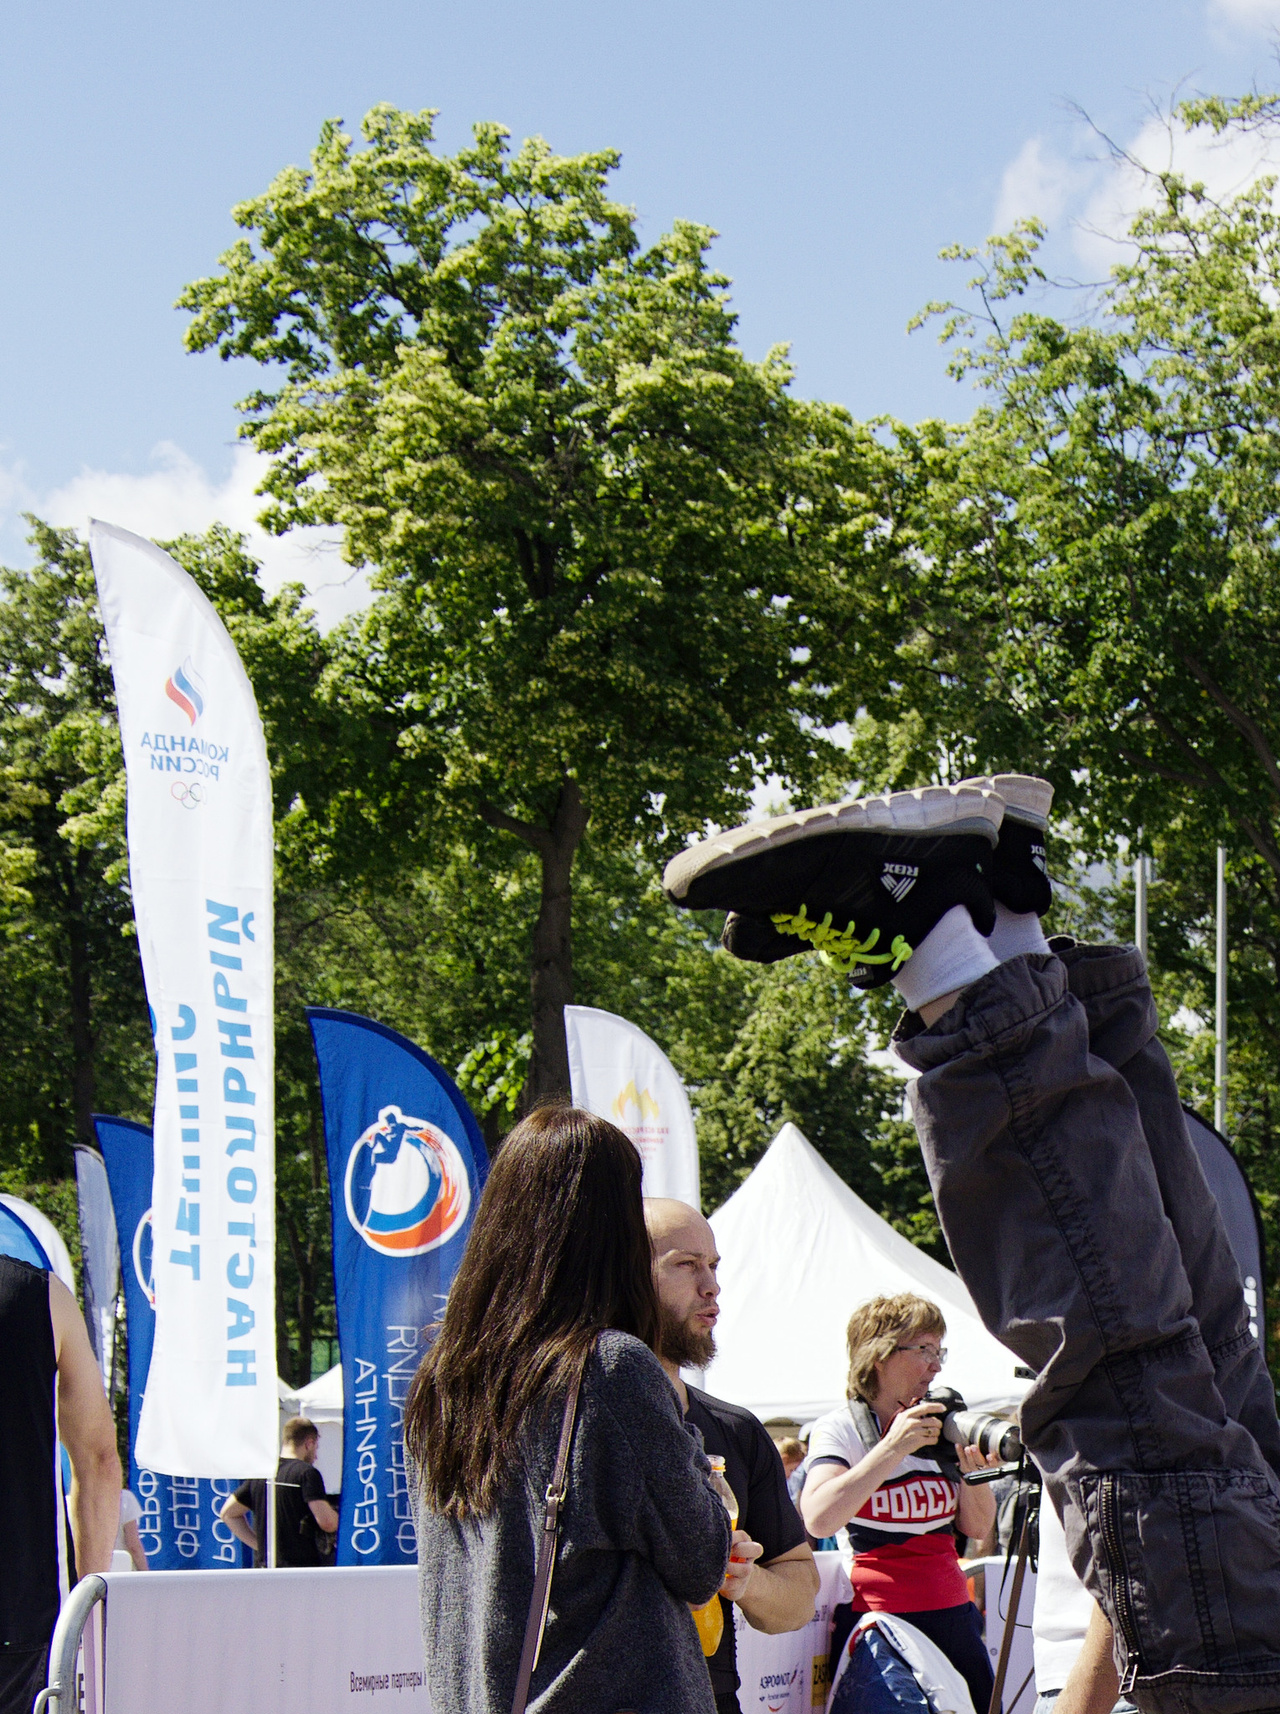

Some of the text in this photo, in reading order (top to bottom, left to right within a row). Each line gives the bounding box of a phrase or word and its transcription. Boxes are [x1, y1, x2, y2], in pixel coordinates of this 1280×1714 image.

[882, 862, 919, 877] RBX
[870, 1480, 958, 1519] РОССИ
[350, 1671, 390, 1696] Всемирные
[391, 1671, 423, 1694] партнеры
